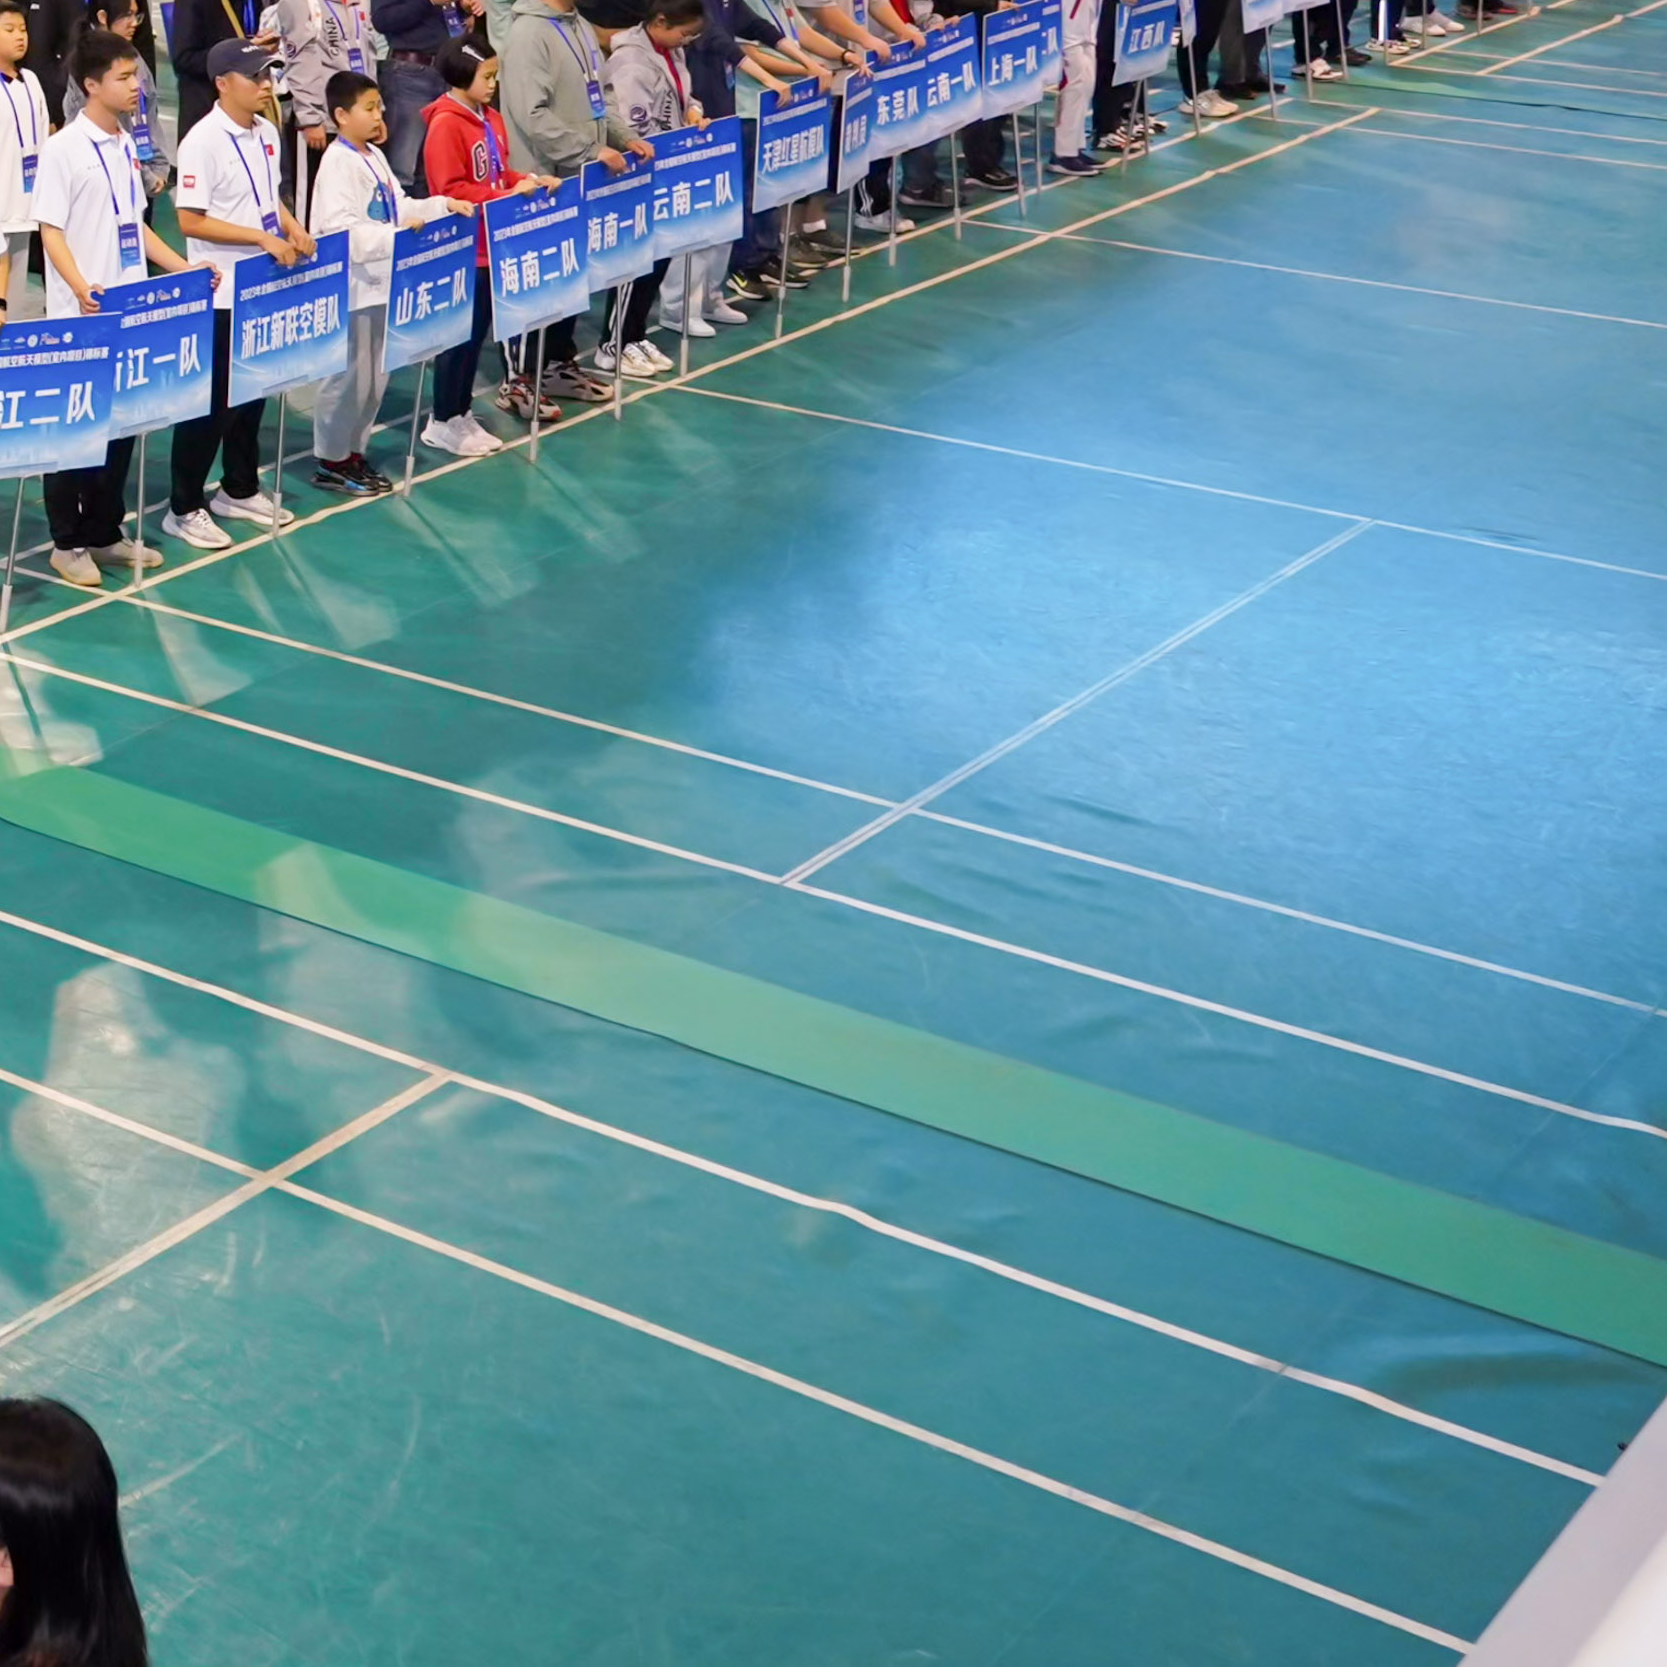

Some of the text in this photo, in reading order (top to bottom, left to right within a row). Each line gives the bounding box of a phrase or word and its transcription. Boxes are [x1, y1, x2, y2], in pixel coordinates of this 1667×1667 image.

[329, 17, 340, 56] CHINA
[1128, 20, 1165, 54] 江西队
[927, 61, 976, 108] 云南一队
[988, 45, 1038, 87] 上海一队
[877, 86, 919, 127] 东莞队
[653, 170, 735, 223] 云南二队
[586, 202, 649, 256] 海南一队
[499, 237, 581, 299] 海南二队
[394, 266, 467, 328] 山东二队
[241, 293, 341, 360] 浙江新联空模队
